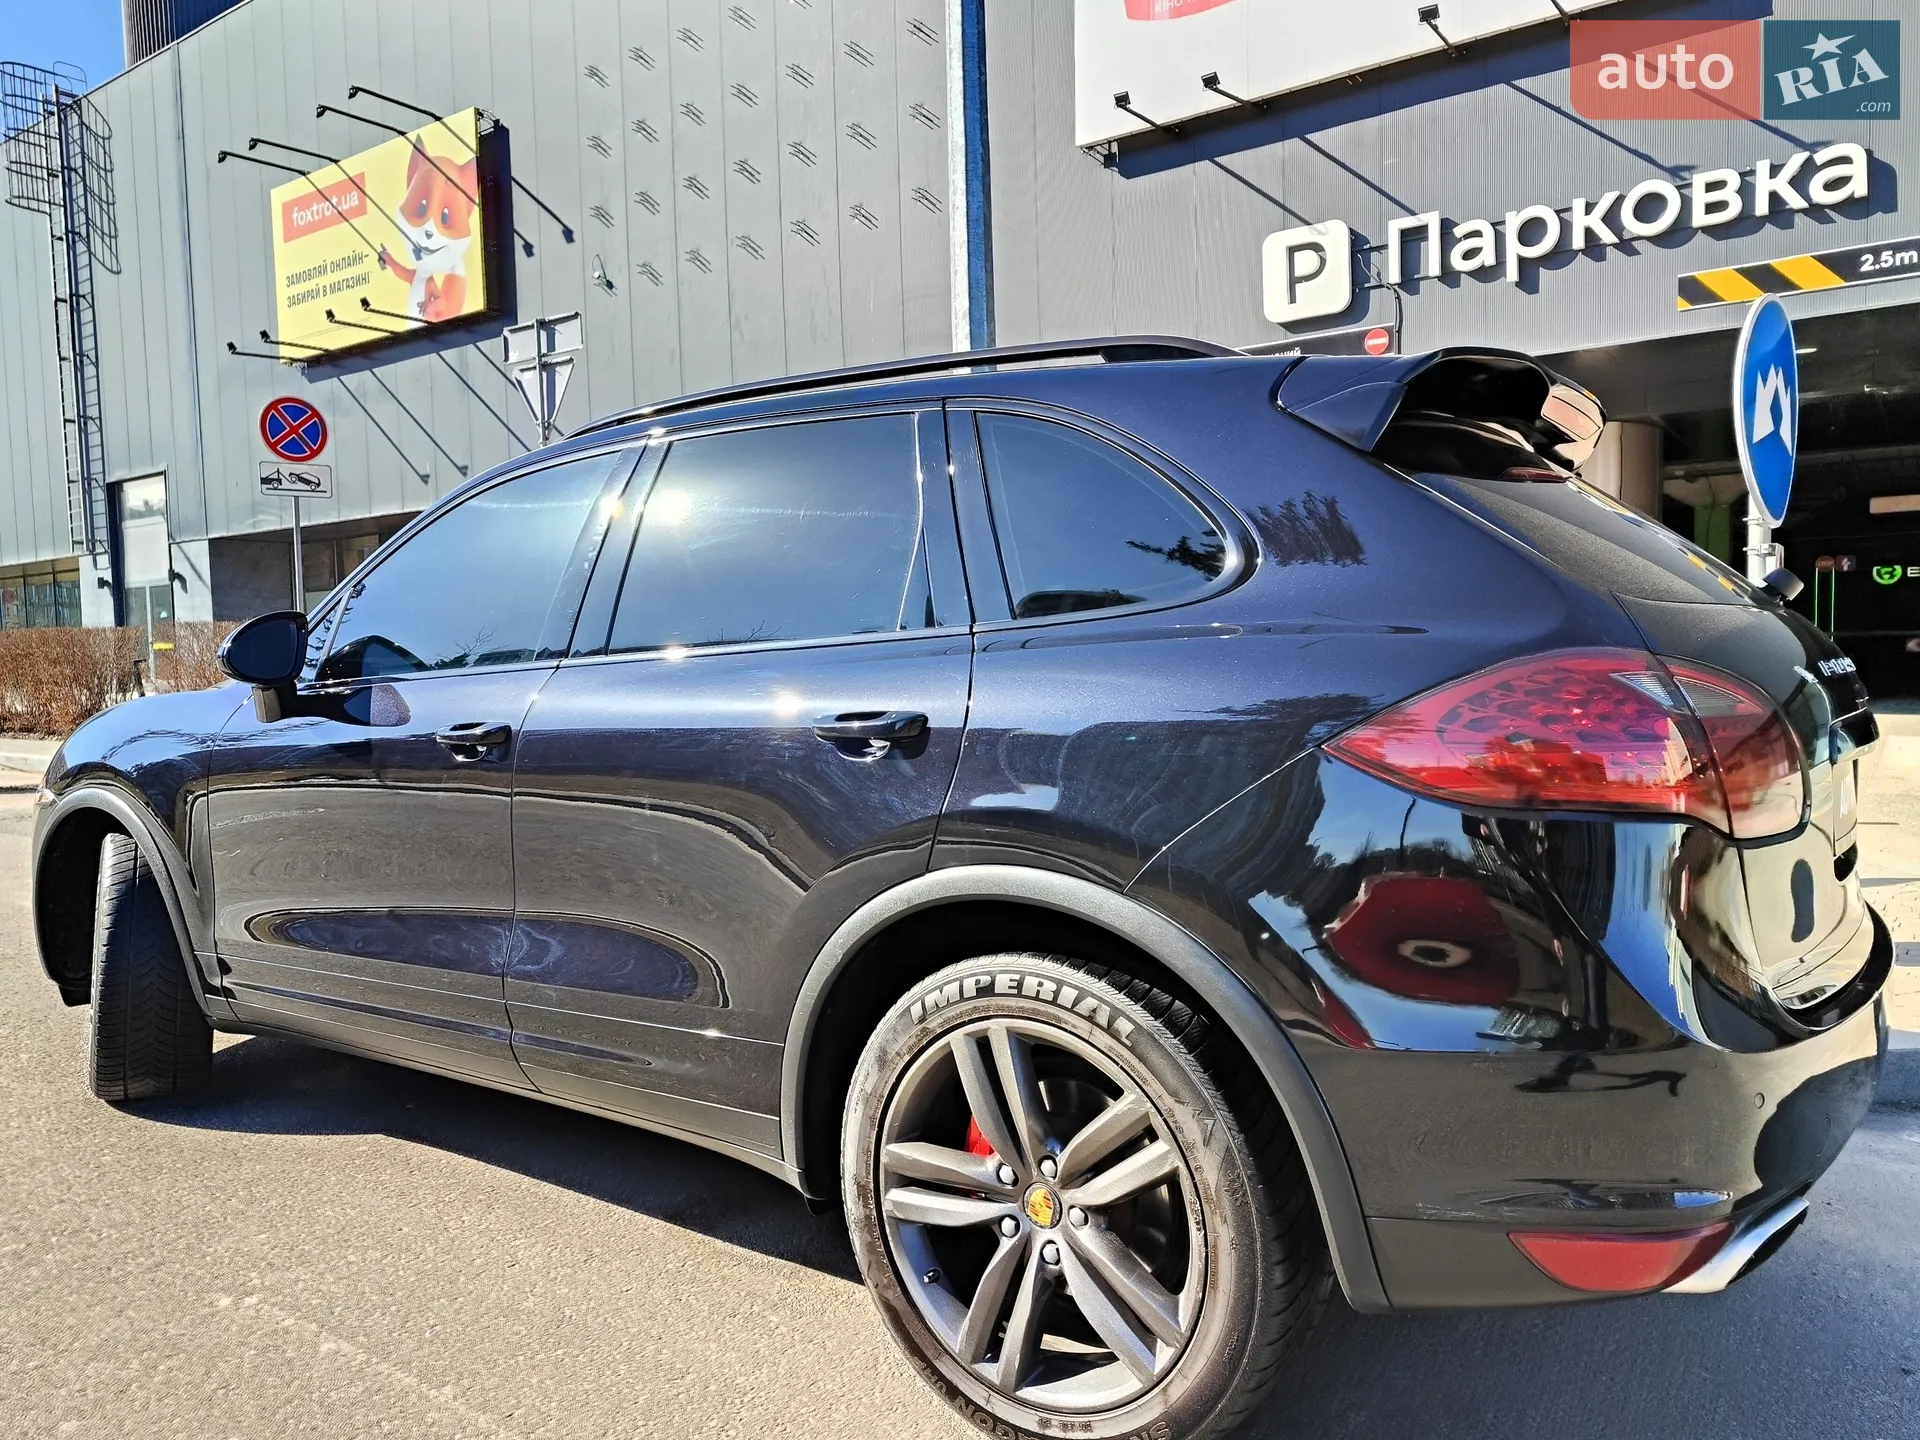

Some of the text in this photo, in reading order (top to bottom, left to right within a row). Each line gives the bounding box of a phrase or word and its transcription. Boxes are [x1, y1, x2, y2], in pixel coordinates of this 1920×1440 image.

[292, 190, 359, 228] foxtrot.ua
[1388, 142, 1869, 285] Парковка
[286, 259, 328, 288] ЗАМОВЛЯЙ
[1860, 250, 1918, 272] 2.5m
[287, 283, 321, 308] ЗАБИРАЙ
[322, 284, 328, 298] В
[909, 973, 1136, 1047] IMPERIAL
